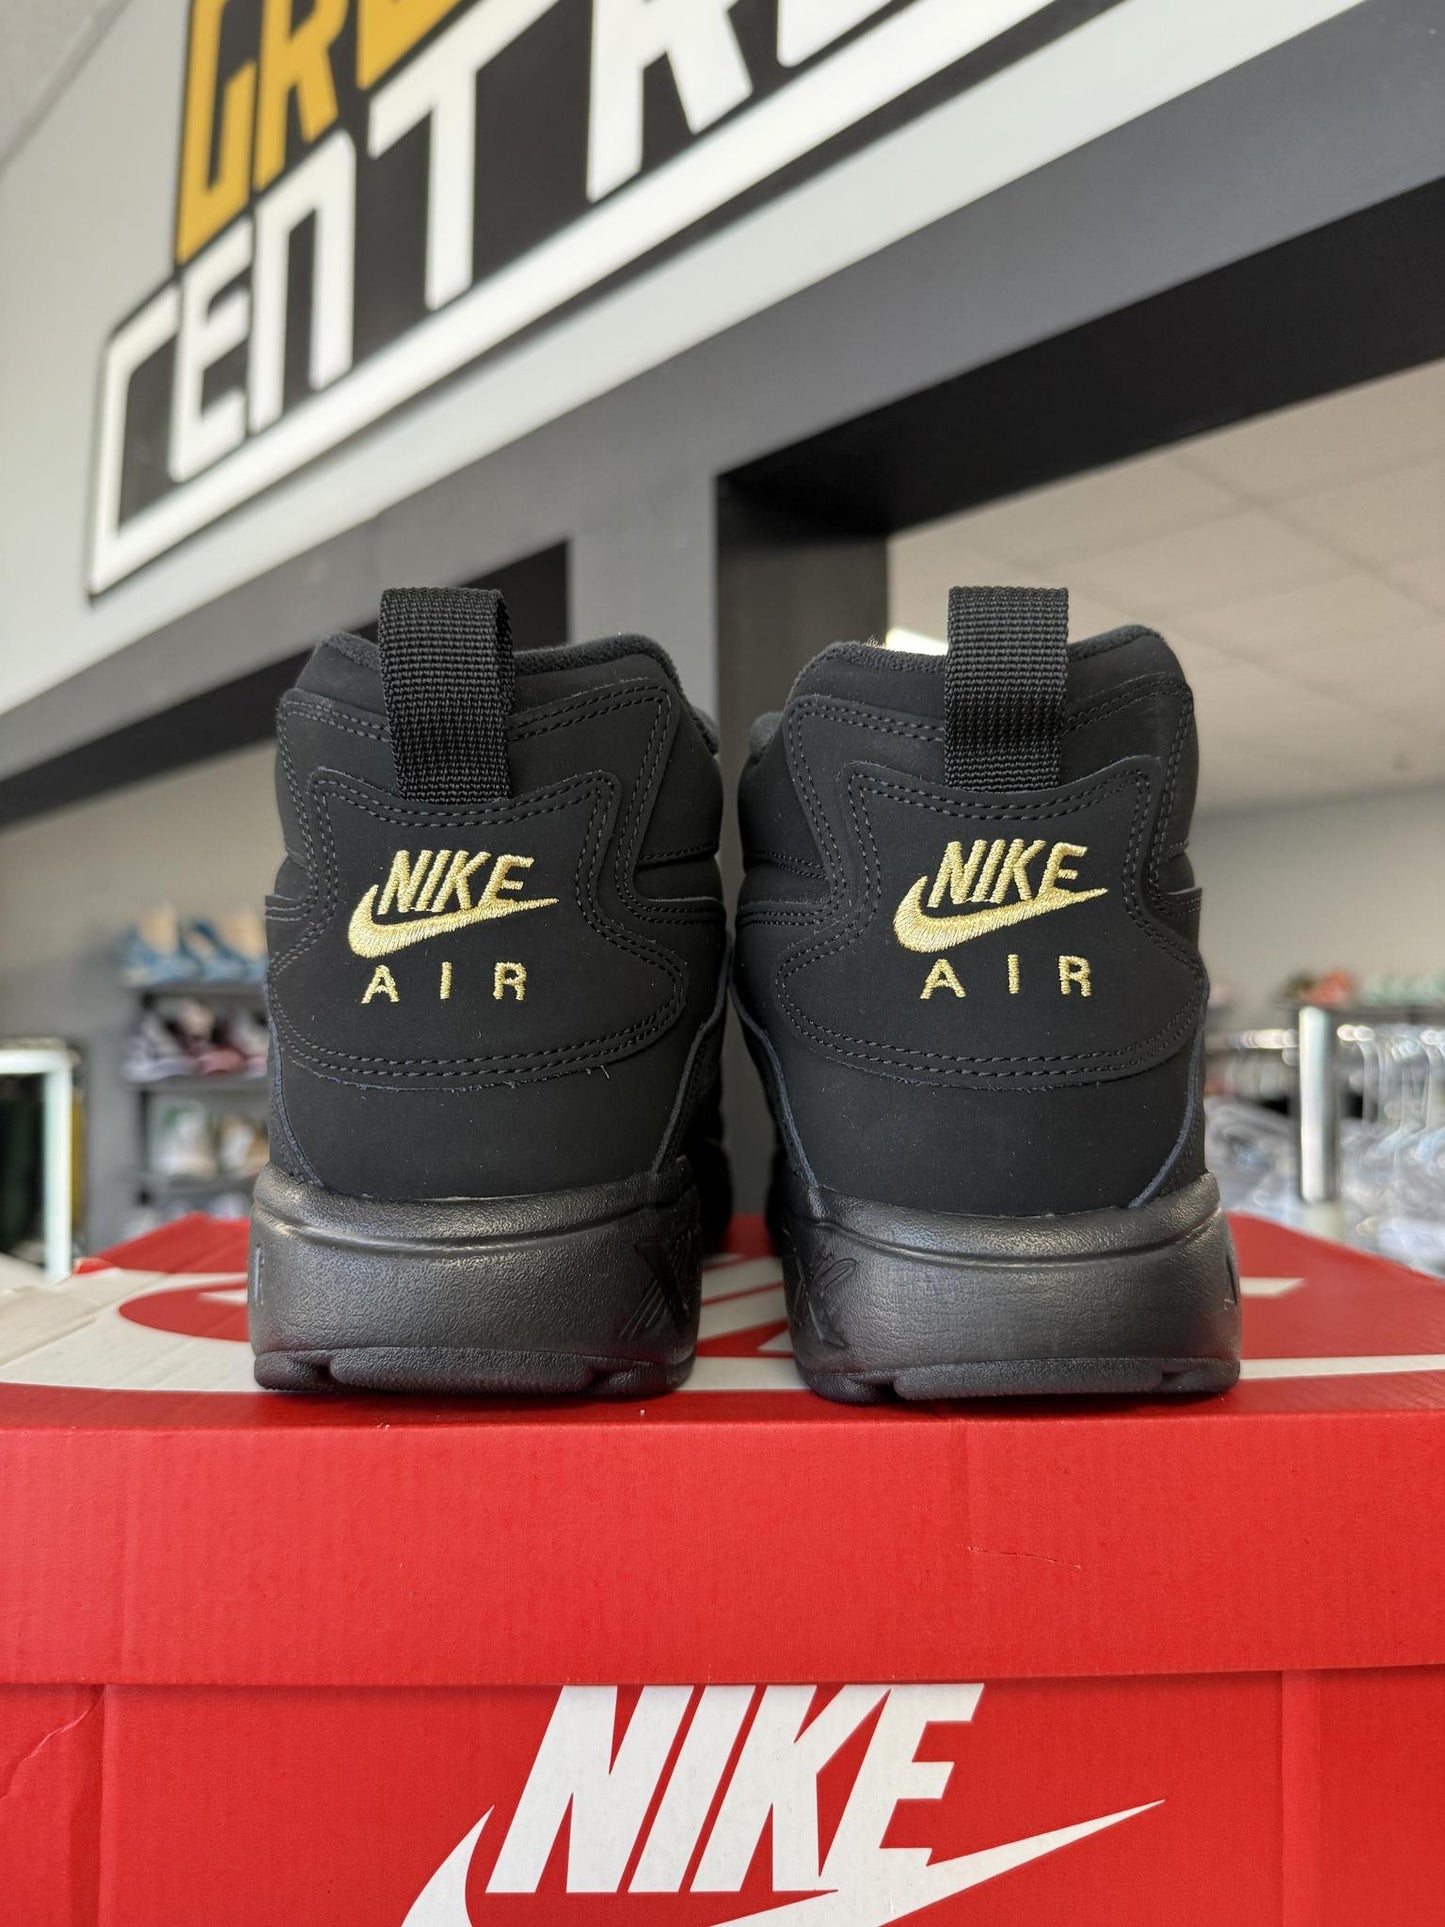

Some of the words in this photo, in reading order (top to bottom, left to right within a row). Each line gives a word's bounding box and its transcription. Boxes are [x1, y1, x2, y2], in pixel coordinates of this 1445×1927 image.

[376, 849, 536, 916] NIKE
[927, 838, 1089, 909] NIKE
[361, 961, 528, 1004] AIR
[919, 953, 1093, 1000] AIR
[485, 1683, 986, 1893] NIKE
